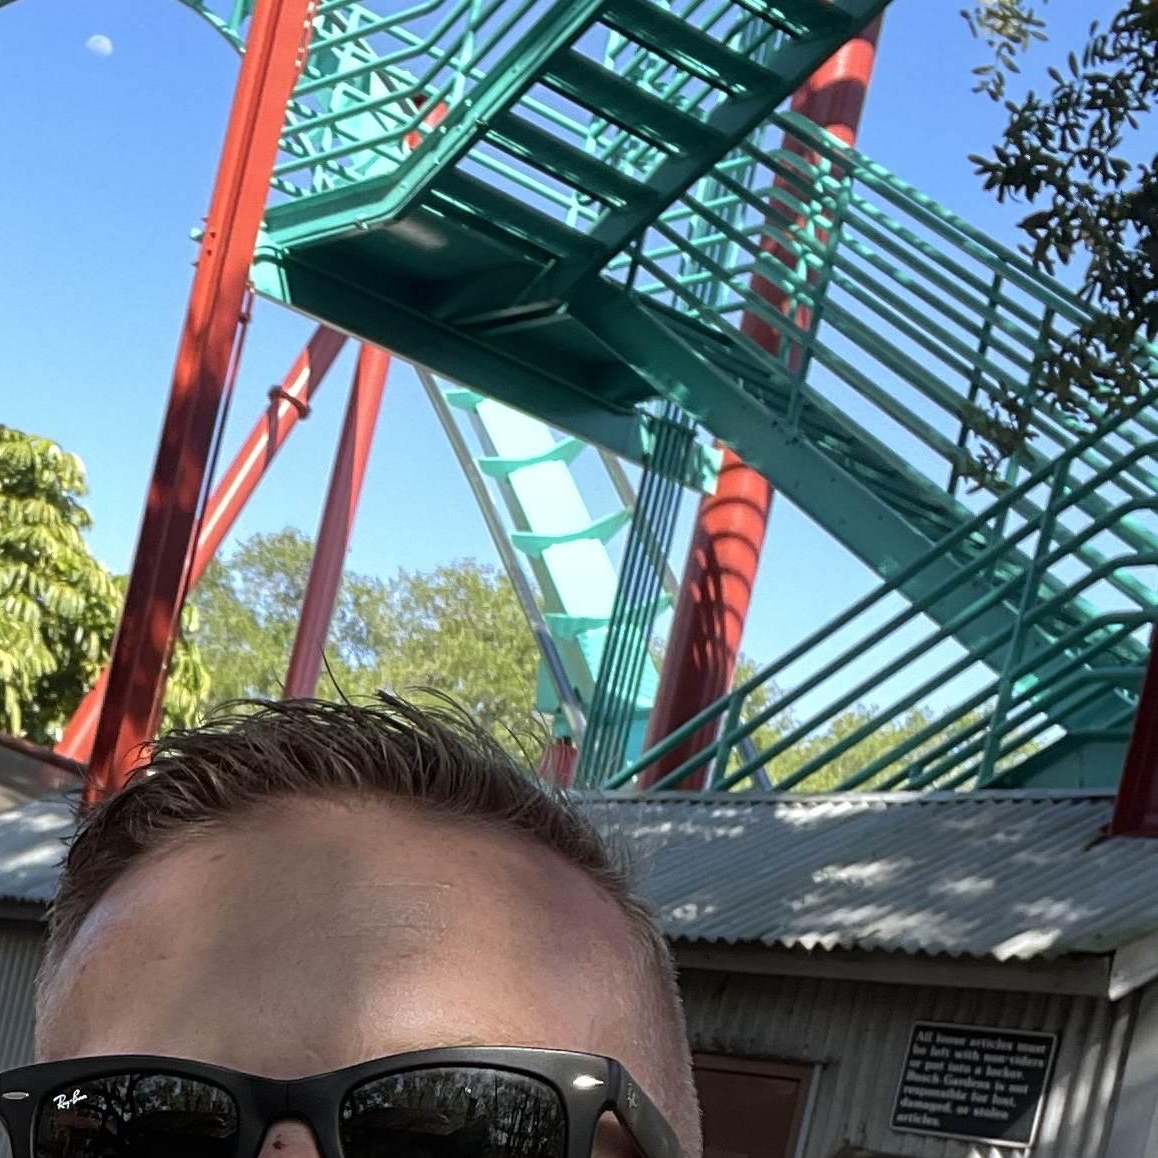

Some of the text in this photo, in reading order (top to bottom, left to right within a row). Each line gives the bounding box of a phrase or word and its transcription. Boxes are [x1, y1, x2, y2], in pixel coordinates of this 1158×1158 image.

[916, 1031, 933, 1042] All
[969, 1038, 1013, 1050] articles
[931, 1046, 949, 1057] left
[954, 1050, 979, 1061] with
[974, 1066, 981, 1075] a
[944, 1074, 990, 1089] Gardens
[995, 1081, 1004, 1091] is
[903, 1086, 967, 1100] responsible
[971, 1092, 988, 1102] for
[956, 1106, 969, 1115] or
[973, 1107, 1008, 1120] stolen
